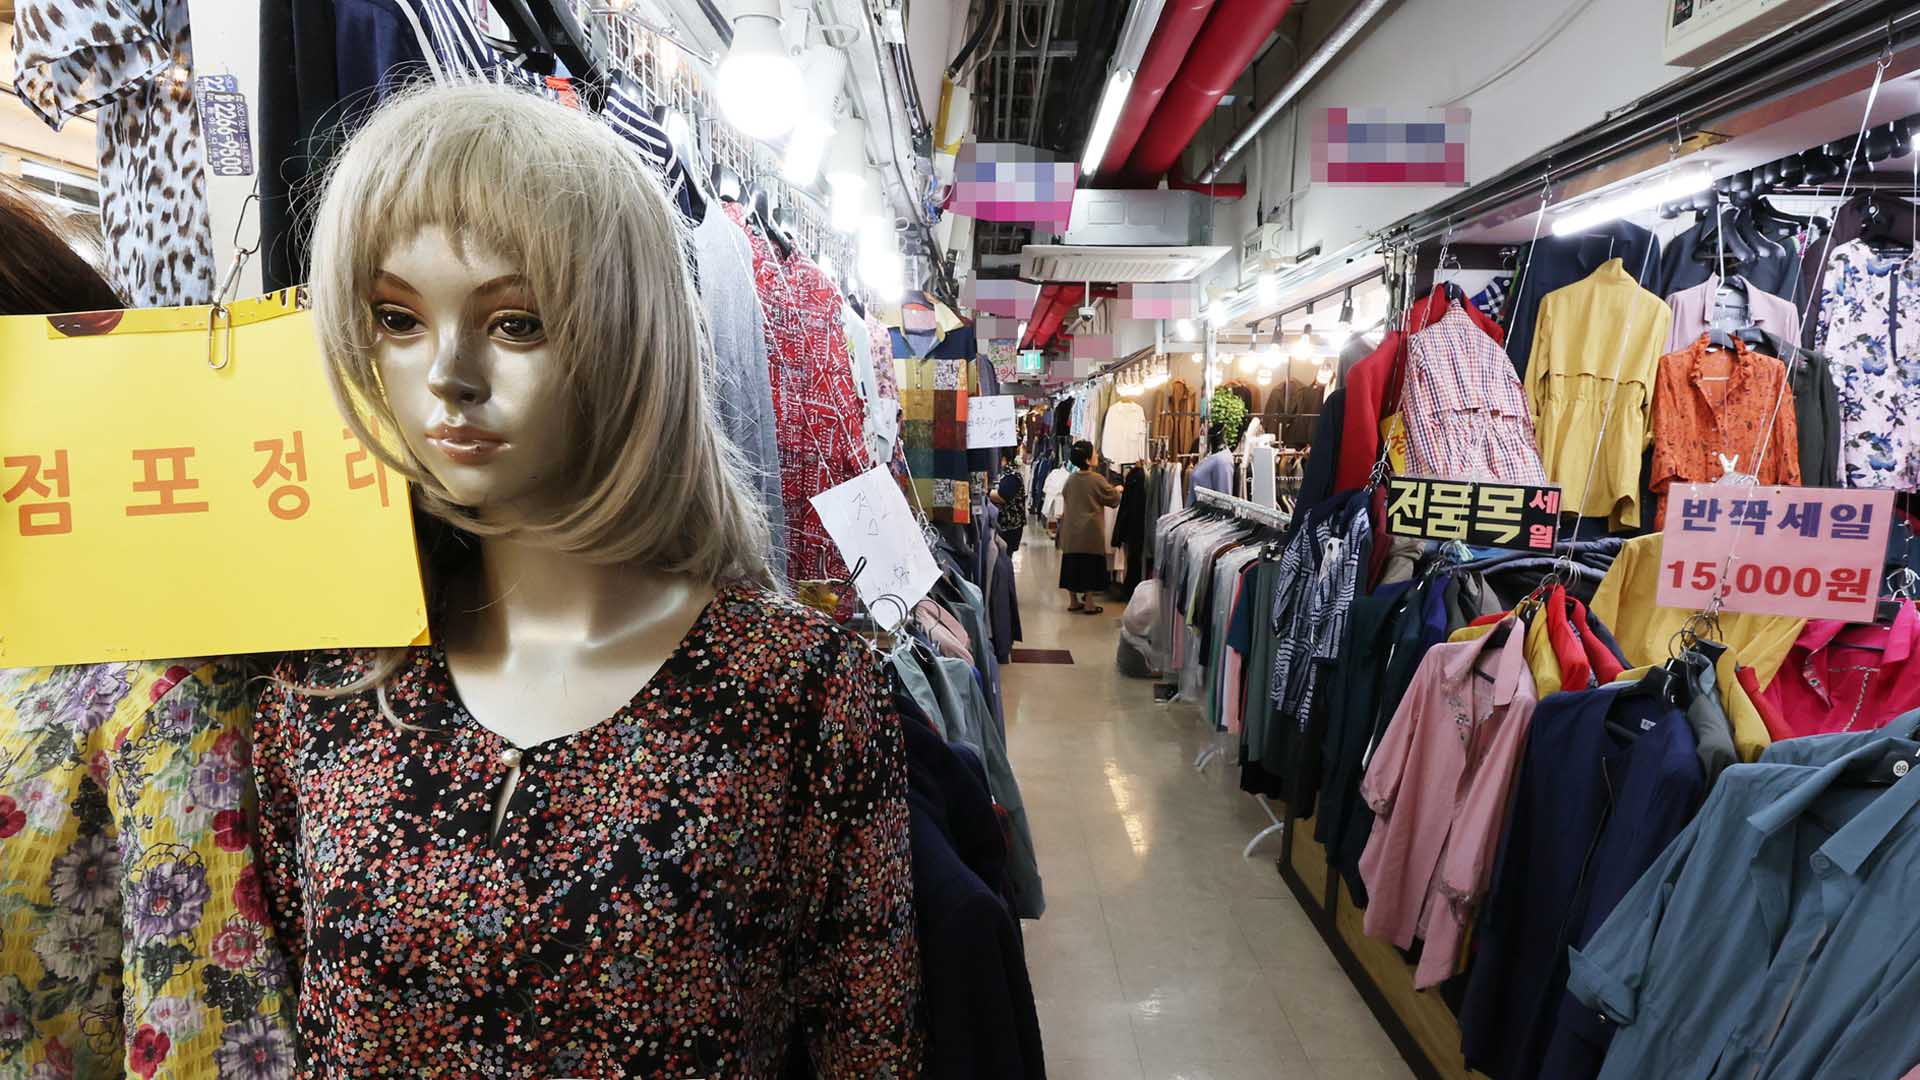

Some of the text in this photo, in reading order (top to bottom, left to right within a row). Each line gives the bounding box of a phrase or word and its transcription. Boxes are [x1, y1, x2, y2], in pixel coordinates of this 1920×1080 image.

[214, 103, 243, 175] 2266-9500
[1387, 480, 1559, 549] 전품목 세일
[1667, 560, 1872, 603] 15,000원
